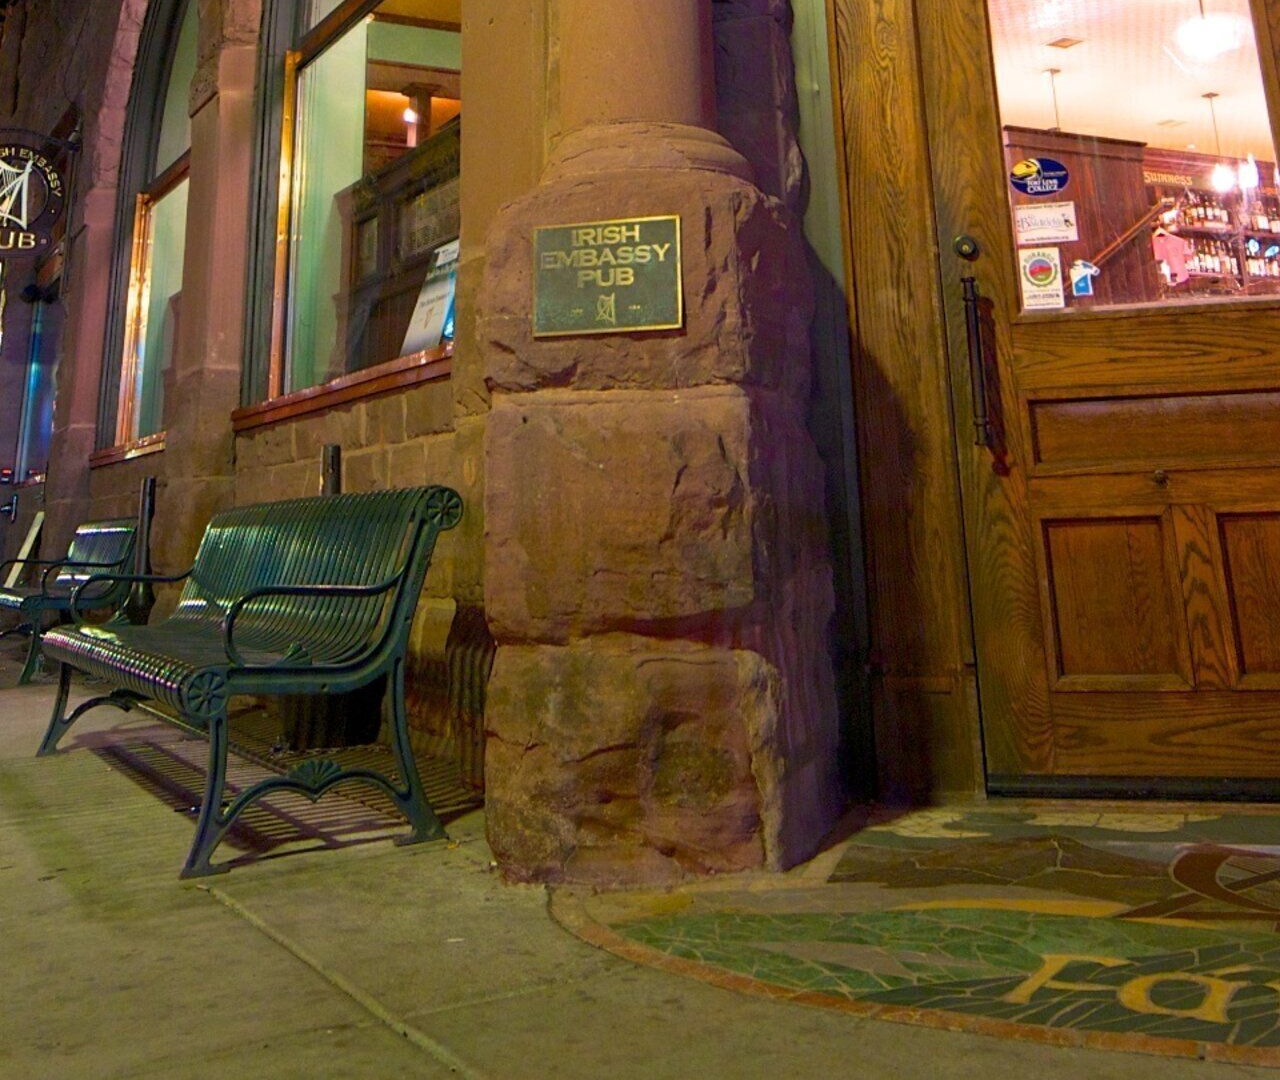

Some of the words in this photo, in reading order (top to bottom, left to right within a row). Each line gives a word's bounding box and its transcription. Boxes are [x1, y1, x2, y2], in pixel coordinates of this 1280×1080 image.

[19, 148, 62, 197] EMBASSY
[571, 224, 640, 247] IRISH
[540, 243, 671, 271] EMBASSY
[577, 267, 634, 288] PUB
